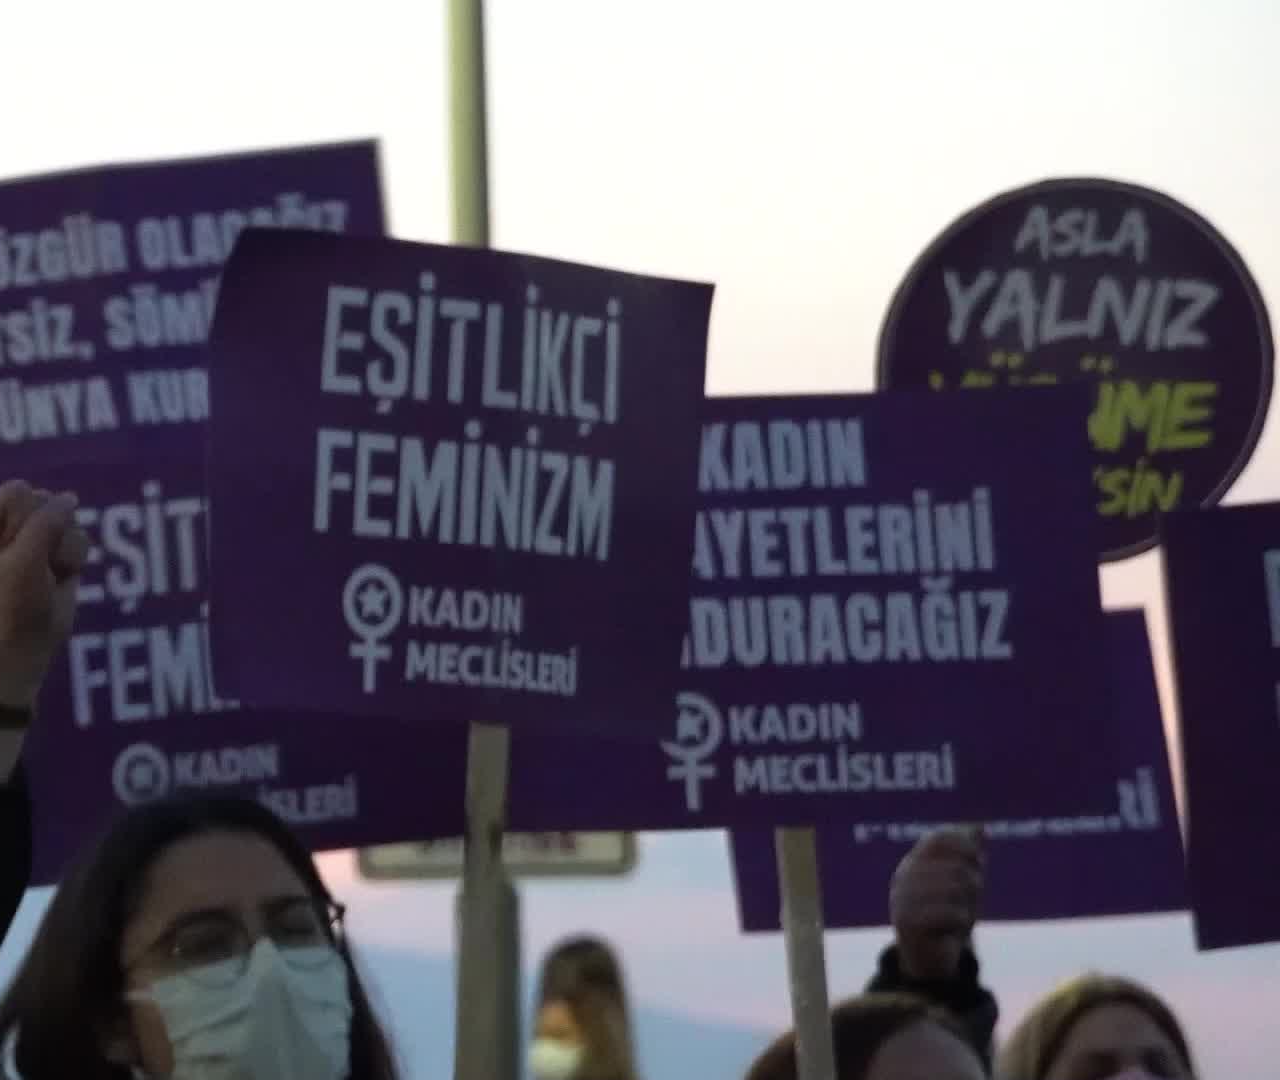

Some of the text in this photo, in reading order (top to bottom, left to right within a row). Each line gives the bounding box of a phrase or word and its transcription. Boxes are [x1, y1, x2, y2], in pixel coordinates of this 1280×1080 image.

[1014, 204, 1149, 263] ASLA
[104, 274, 222, 350] SÖM
[944, 269, 1222, 351] YALNIZ
[320, 271, 621, 437] EŞİTLİKÇİ
[313, 420, 616, 562] FEMİNİZM
[697, 418, 866, 492] KADIN
[1094, 457, 1183, 518] SİN
[74, 480, 210, 613] EŞİT
[408, 586, 523, 633] KADIN
[680, 575, 1013, 669] DURACAĞIZ
[69, 602, 240, 728] FEM
[404, 639, 579, 695] MECLİSLERİ
[728, 702, 861, 742] KADIN
[174, 744, 279, 788] KADIN
[734, 742, 955, 795] MECLİSLERİ
